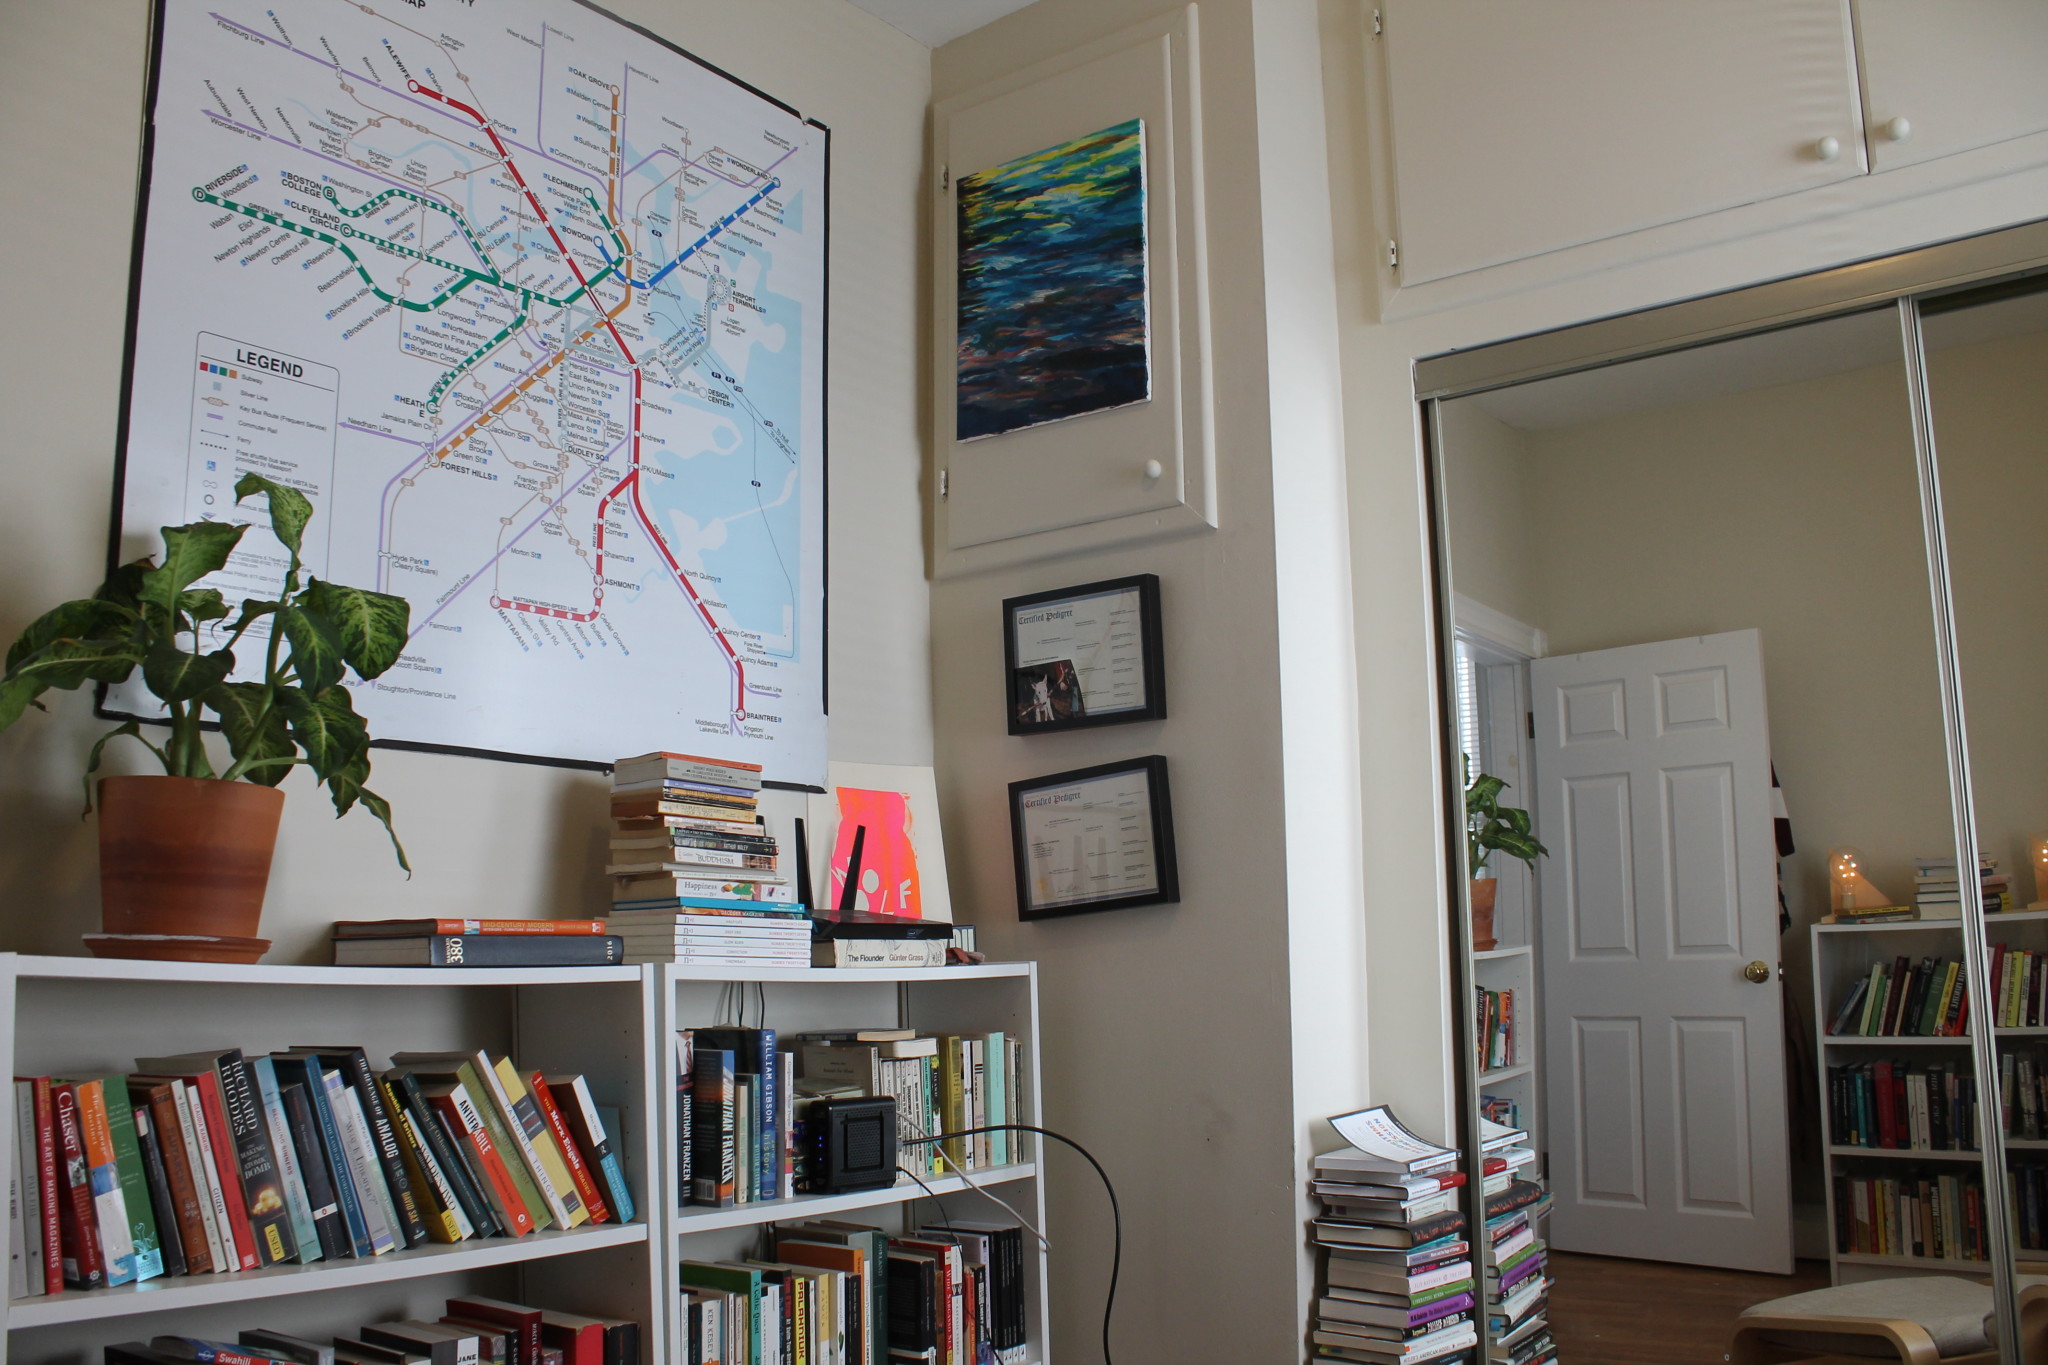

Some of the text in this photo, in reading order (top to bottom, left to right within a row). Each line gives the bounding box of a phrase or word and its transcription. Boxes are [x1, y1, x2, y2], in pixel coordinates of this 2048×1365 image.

[402, 0, 426, 8] AP
[250, 35, 265, 46] Line
[386, 45, 411, 80] ALEWIFE
[573, 69, 611, 91] OAK GROVE
[205, 166, 244, 192] RIVERSIDE
[287, 172, 322, 191] BOSTON
[731, 160, 768, 181] WONDERLAND
[221, 176, 253, 199] Woodland
[281, 179, 322, 199] COLLEGE
[547, 174, 583, 194] LECHMERE
[209, 212, 235, 230] Waban
[290, 201, 341, 223] CLEVELAND
[238, 219, 254, 232] Eliot
[309, 216, 340, 232] CIRCLE
[562, 226, 594, 243] BOWDOIN
[271, 242, 299, 266] Chestnut
[306, 245, 336, 269] Reservoir
[317, 265, 356, 293] Beaconsfield
[330, 296, 357, 317] Brookline
[732, 290, 756, 303] AIRPORT
[732, 297, 763, 314] TERMINALS
[346, 316, 374, 337] Brookline
[236, 348, 304, 378] LEGEND
[400, 396, 426, 409] HEATH
[707, 388, 730, 401] DESIGN
[707, 396, 731, 408] CENTER
[568, 445, 605, 461] DUDLEY SQ
[441, 461, 493, 481] FOREST HILLS
[604, 579, 636, 590] ASHMONT
[702, 598, 728, 609] Wollaston
[498, 609, 526, 647] MATTAPAN
[746, 713, 778, 723] BRAINTREE
[695, 853, 735, 865] BUDDHISM
[684, 881, 718, 892] Happiness
[482, 921, 526, 929] MID-CENTURY
[450, 937, 464, 964] 380
[848, 952, 924, 963] The Flounder Günter Grass
[232, 1058, 258, 1131] RICHARD
[362, 1073, 379, 1106] REVENGE
[221, 1065, 247, 1137] RHODES
[375, 1107, 383, 1116] OF
[765, 1084, 773, 1123] GIBSON
[57, 1091, 77, 1152] Chaser
[384, 1082, 401, 1113] Republic
[402, 1120, 417, 1149] Drivers
[458, 1099, 492, 1155] ANTIFRAGILE
[682, 1094, 691, 1181] JONATHAN FRANZEN
[721, 1073, 734, 1184] JONATHAN FRANZEN
[376, 1118, 399, 1159] ANALOG
[544, 1097, 553, 1111] THE
[577, 1169, 592, 1196] READER
[505, 1103, 555, 1199] TANGIBLE THINGS
[244, 1162, 271, 1181] BOMB
[418, 1143, 457, 1212] WALDEN TWO
[42, 1126, 60, 1270] THE ART OF MAKING MAGAZINES
[212, 1187, 224, 1216] CITIZEN
[401, 1191, 418, 1224] DAVID SAX
[445, 1214, 458, 1238] USED
[267, 1228, 281, 1257] USED
[752, 1312, 760, 1335] Quest
[798, 1281, 806, 1360] PALAHNIUK
[218, 1353, 252, 1365] Swahili
[457, 1353, 477, 1364] JANE
